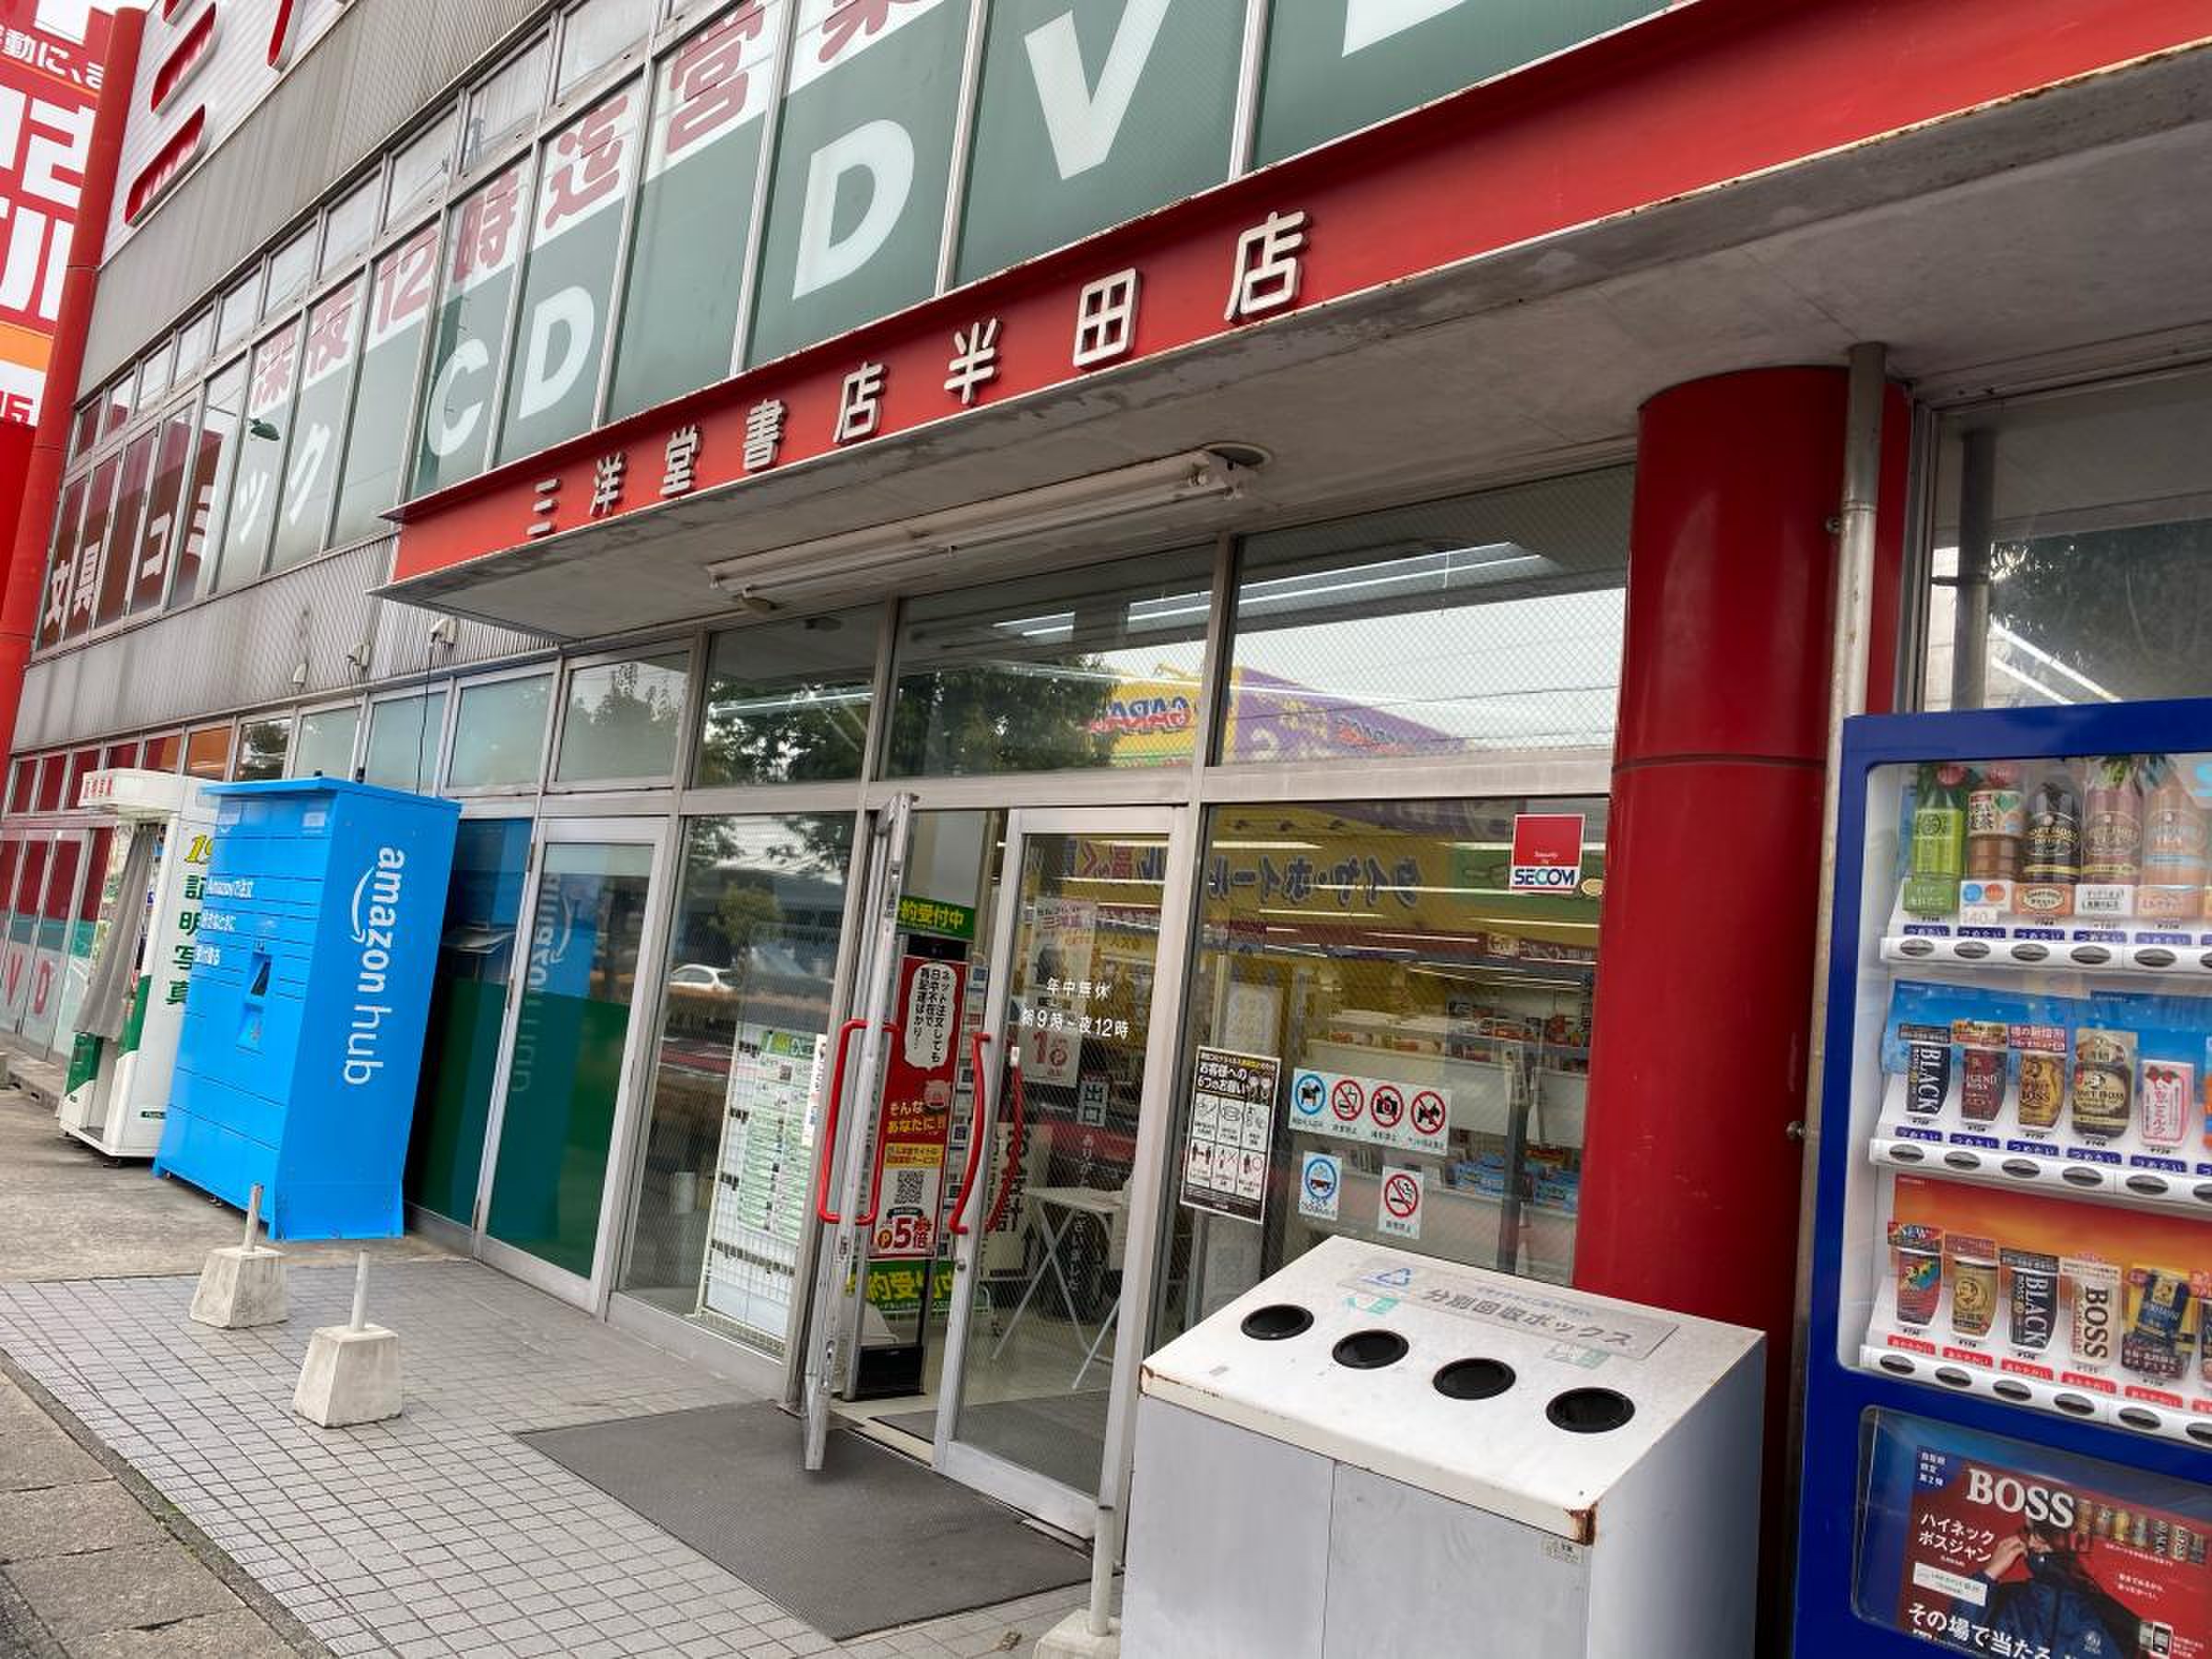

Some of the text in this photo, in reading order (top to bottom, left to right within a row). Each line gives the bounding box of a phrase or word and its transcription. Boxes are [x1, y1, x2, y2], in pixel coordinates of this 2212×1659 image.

[0, 25, 104, 89] 動に、
[526, 209, 1311, 537] 三洋堂書店半田店
[1514, 868, 1575, 886] SECOM
[344, 846, 406, 1086] amazon hub
[1046, 977, 1111, 1002] 年中無休
[1918, 1045, 1942, 1114] BLACK
[1422, 1288, 1639, 1346] 分別回収ボックス
[2024, 1274, 2049, 1349] BLACK
[2083, 1286, 2109, 1359] BOSS
[1966, 1467, 2075, 1528] BOSS
[1918, 1531, 1993, 1563] ボスジャン
[1921, 1512, 1995, 1546] ハイネック
[1908, 1602, 2078, 1659] その場で当たる
